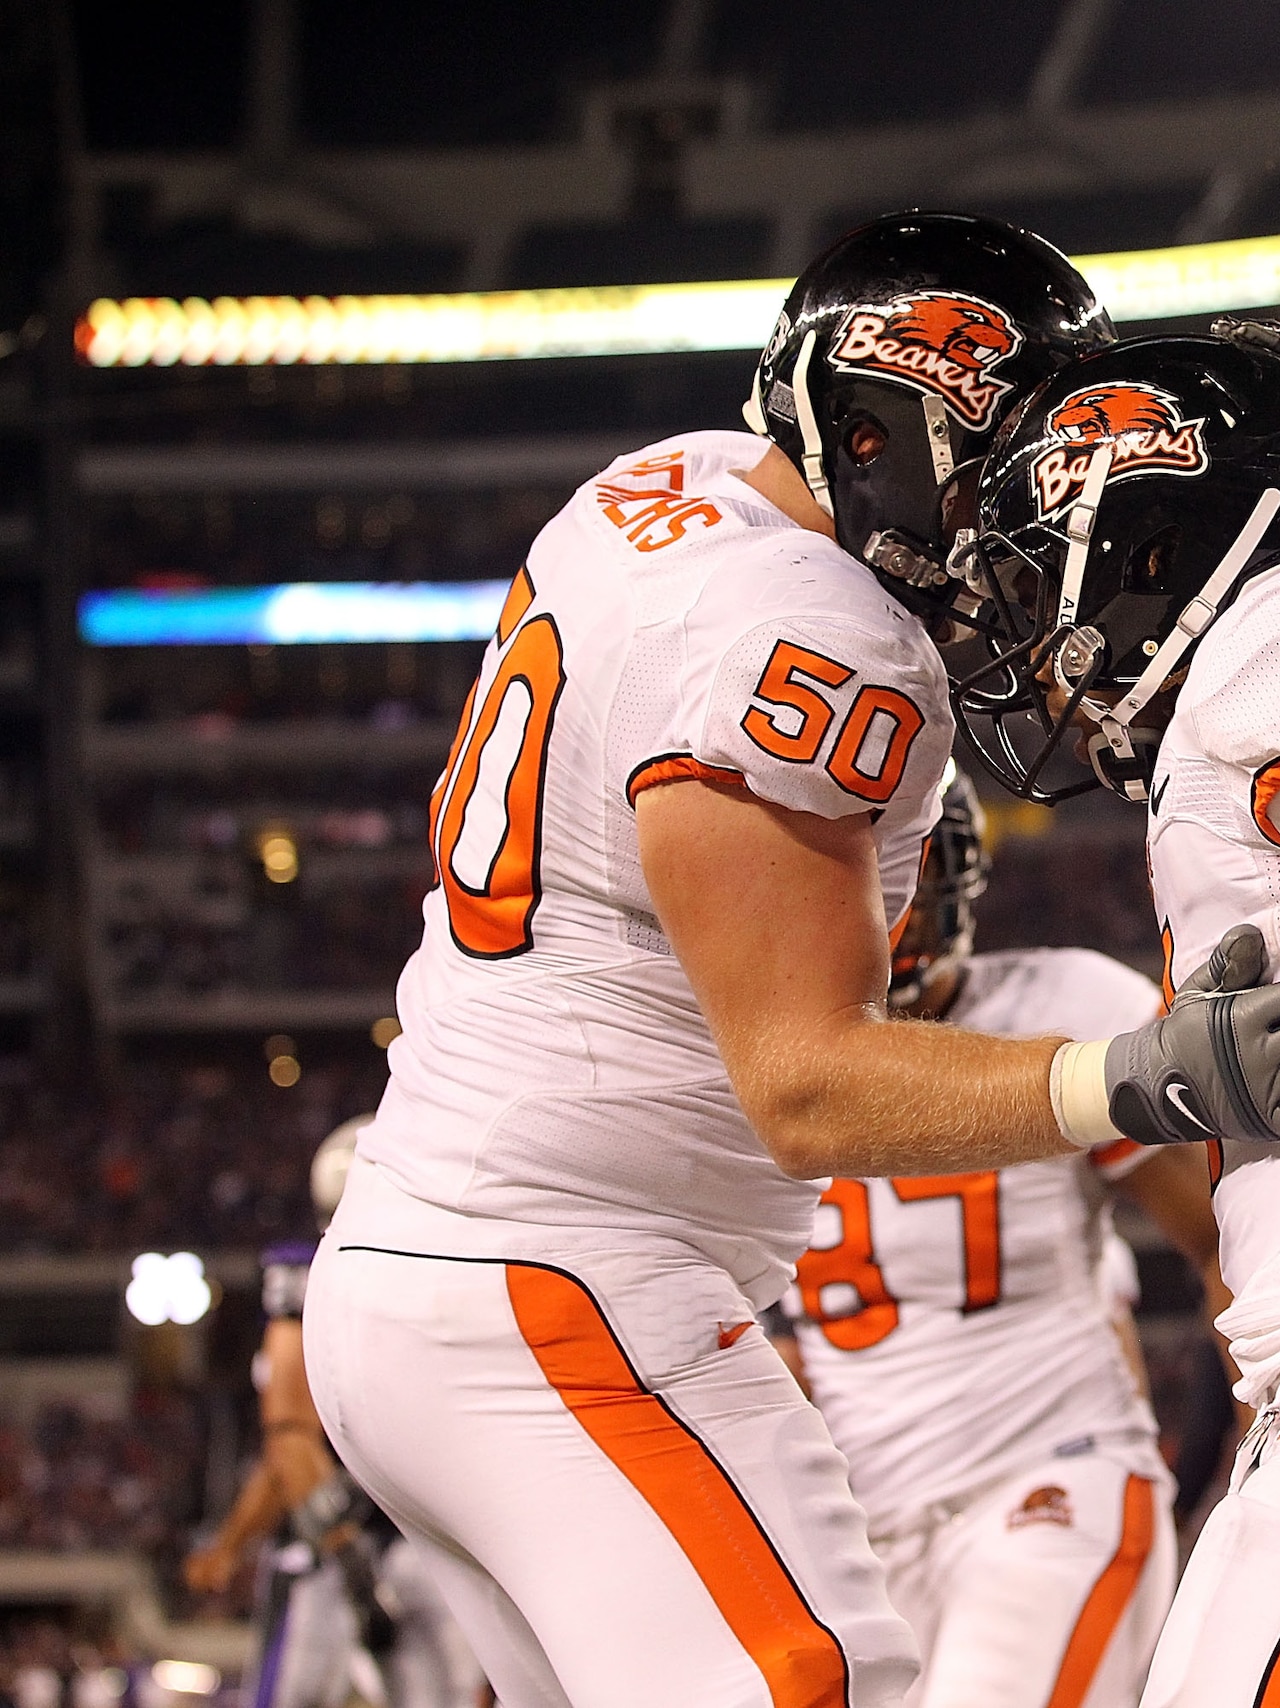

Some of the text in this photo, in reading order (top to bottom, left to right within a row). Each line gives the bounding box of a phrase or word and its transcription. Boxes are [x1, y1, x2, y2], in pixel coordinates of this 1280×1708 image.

[837, 313, 1000, 412] Beavers
[740, 638, 926, 804] 50
[795, 1168, 1002, 1351] 87
